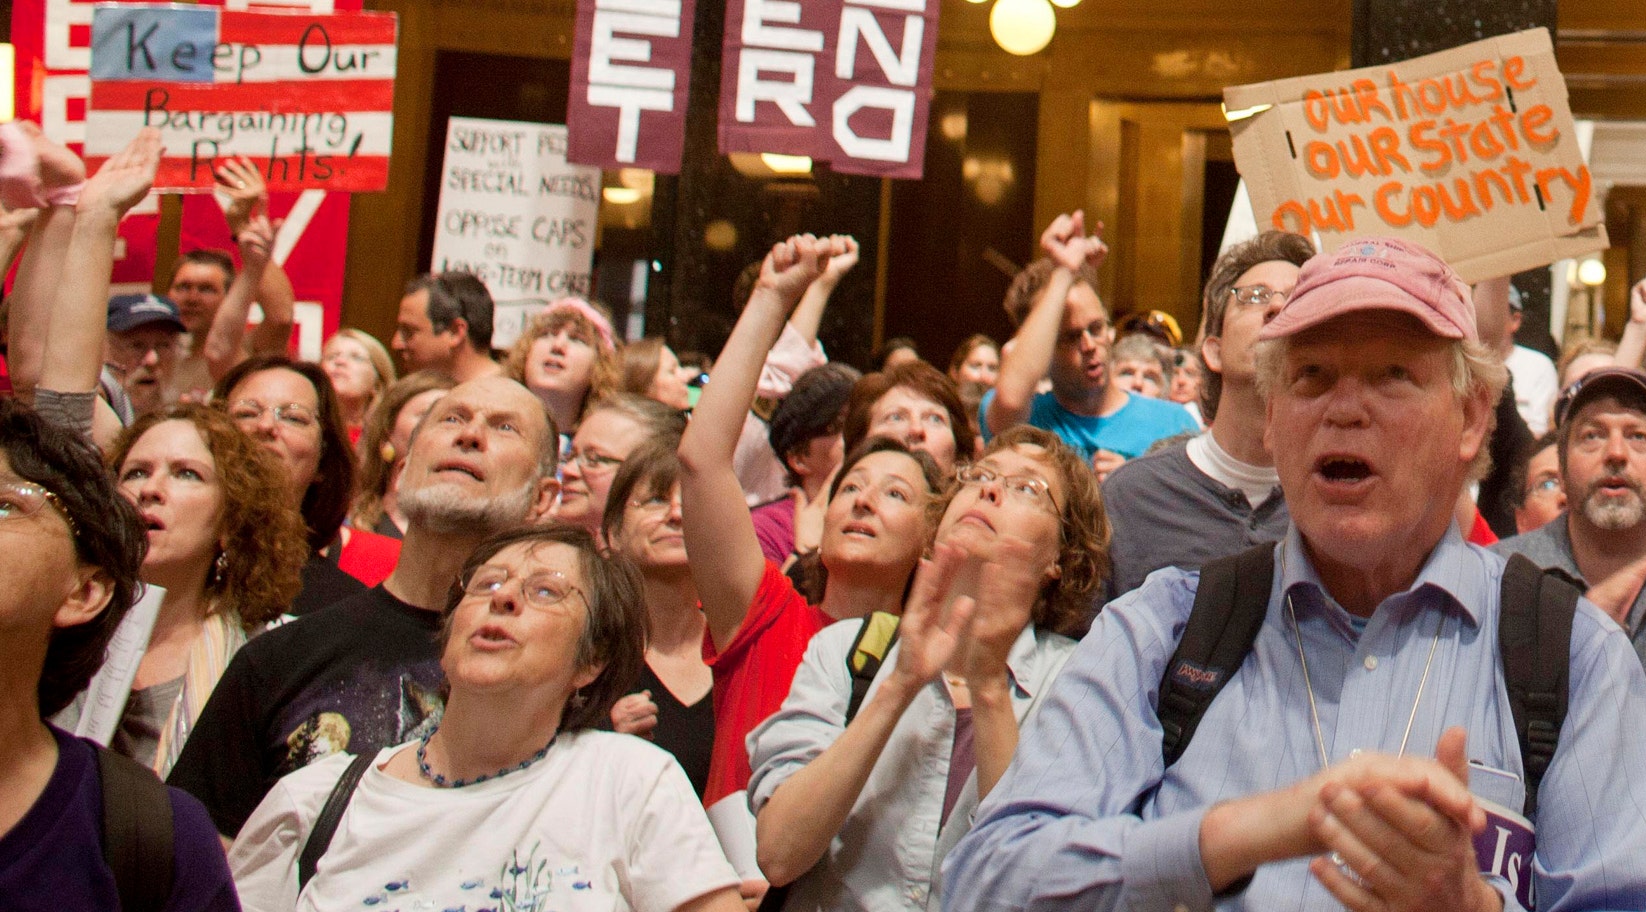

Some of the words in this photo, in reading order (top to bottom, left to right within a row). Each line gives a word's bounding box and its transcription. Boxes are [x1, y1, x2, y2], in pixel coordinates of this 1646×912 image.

[125, 20, 261, 84] Keep
[298, 22, 381, 74] Our
[1388, 55, 1538, 122] house
[144, 87, 348, 147] Bargaining
[451, 127, 526, 155] SUPPORT
[1409, 104, 1560, 172] State
[190, 131, 364, 182] Rhts!
[449, 166, 530, 197] SPECIAL
[445, 209, 523, 240] OPPOSE
[531, 215, 587, 249] CAPS
[1272, 189, 1366, 237] our
